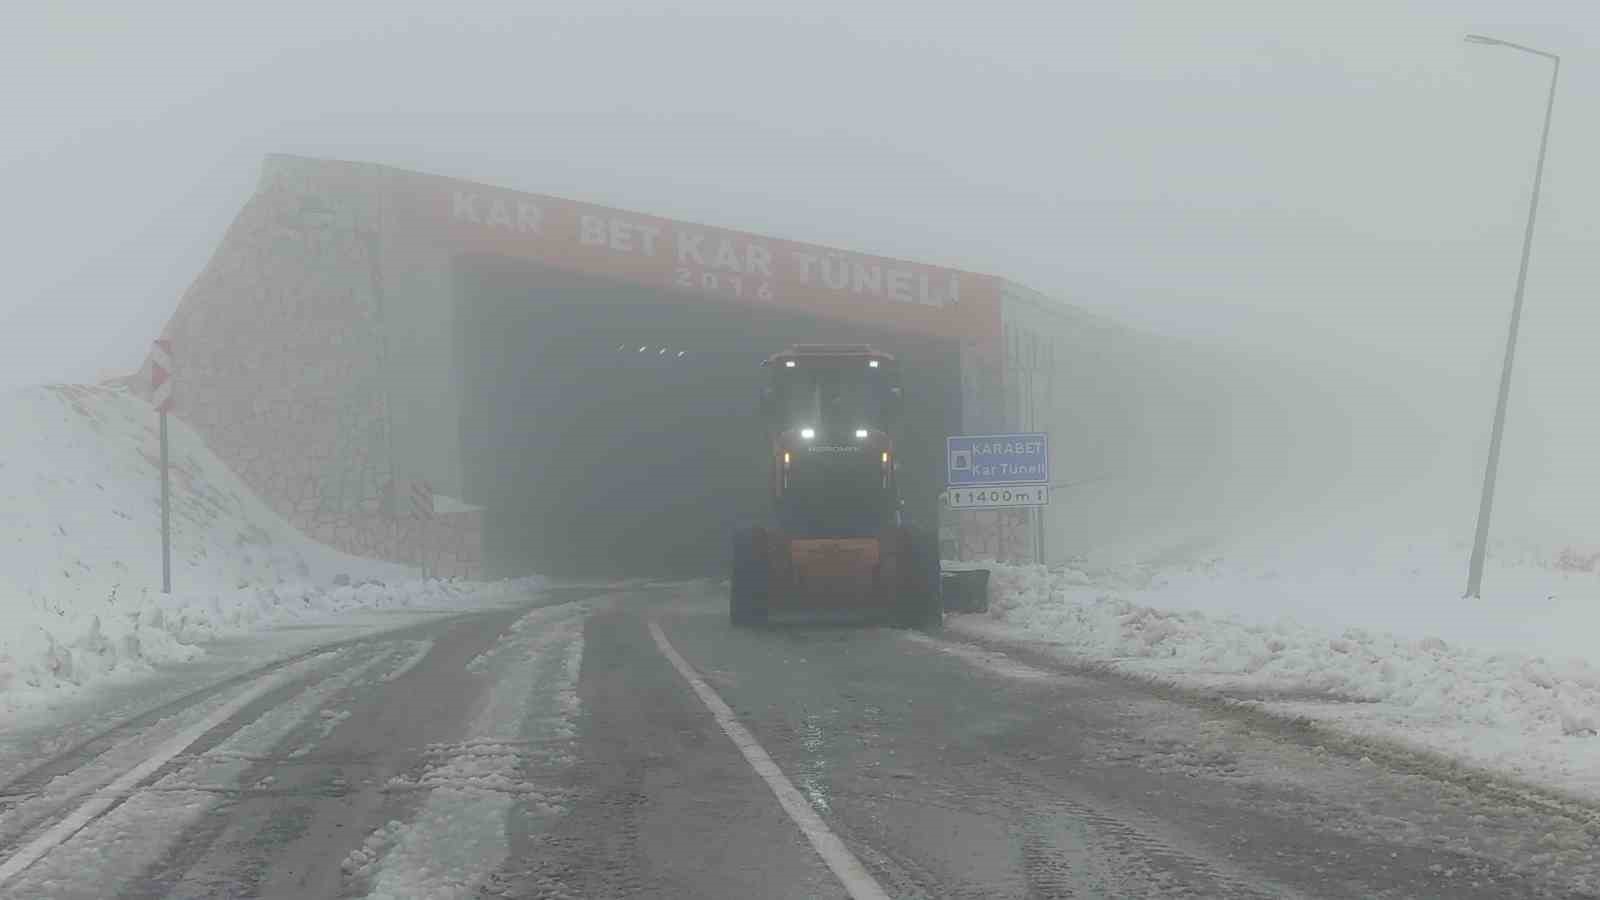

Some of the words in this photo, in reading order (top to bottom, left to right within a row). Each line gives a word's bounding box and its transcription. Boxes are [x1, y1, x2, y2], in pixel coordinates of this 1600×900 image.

[451, 191, 543, 234] KAR
[579, 214, 661, 257] BET
[674, 231, 774, 278] KAR
[971, 440, 1042, 456] KARABET
[971, 463, 997, 478] Kar
